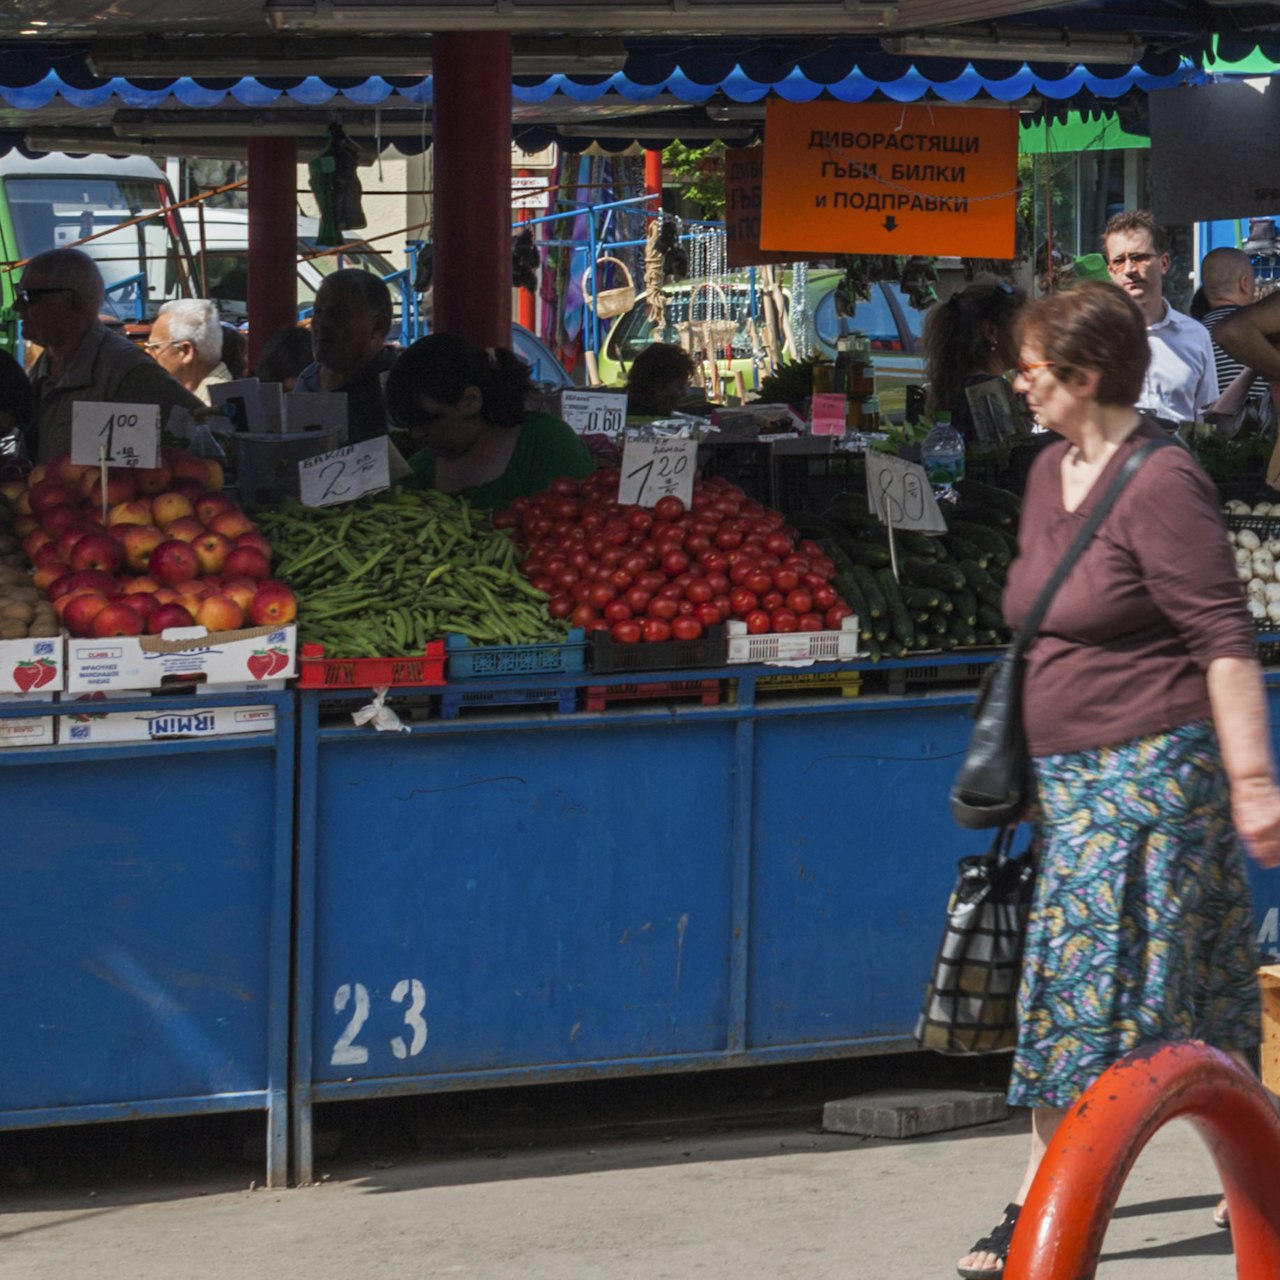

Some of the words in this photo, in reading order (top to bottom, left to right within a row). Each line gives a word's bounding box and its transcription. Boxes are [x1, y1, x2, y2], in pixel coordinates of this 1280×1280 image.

[808, 130, 980, 156] ДИВОРАСТЯЩИ
[891, 164, 966, 183] БИЛКИ
[833, 192, 969, 214] ПОДПРАВКИ
[588, 411, 622, 431] 0.60
[319, 461, 352, 500] 2
[330, 978, 428, 1066] 23
